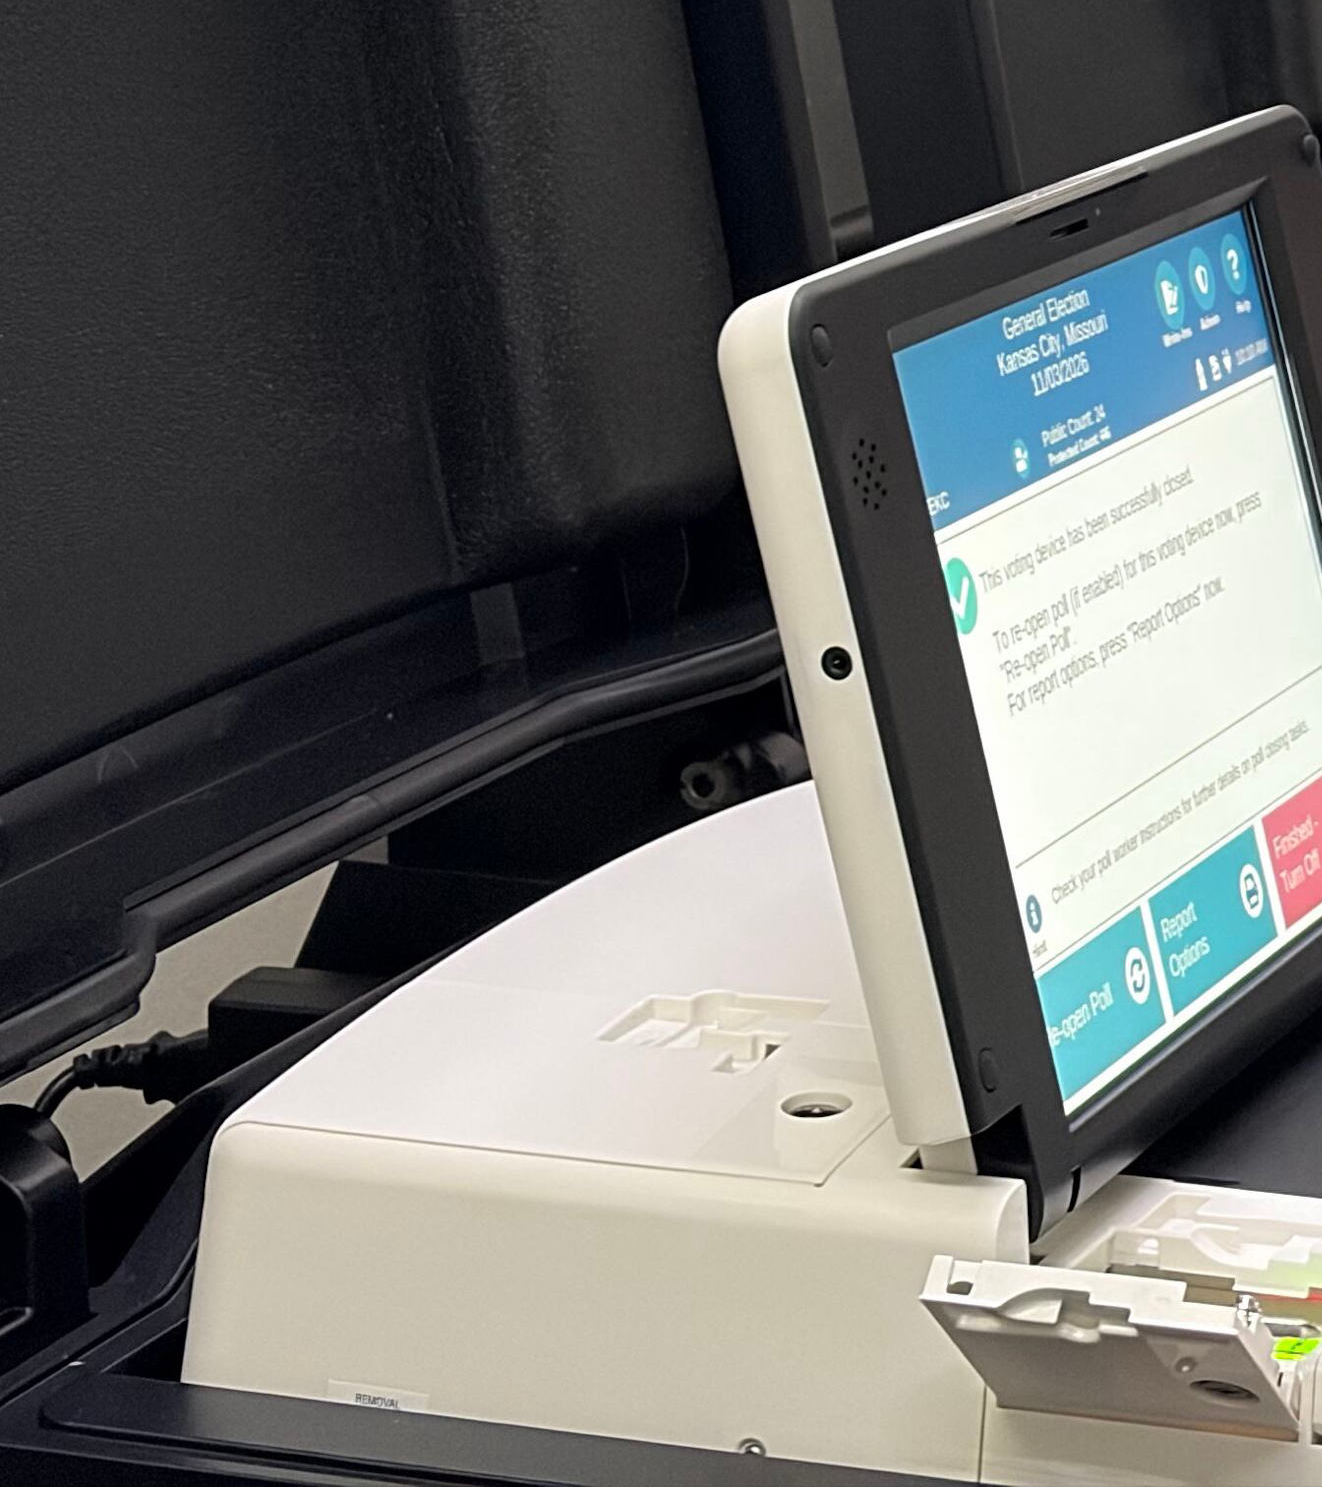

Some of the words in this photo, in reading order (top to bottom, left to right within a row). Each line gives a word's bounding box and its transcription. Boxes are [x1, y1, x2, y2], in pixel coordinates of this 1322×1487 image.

[1002, 303, 1046, 340] General
[1046, 290, 1090, 322] Election
[997, 344, 1040, 376] Kansas
[1039, 333, 1065, 358] City,
[1063, 309, 1108, 346] Missouri
[1031, 351, 1089, 396] 11/03/2026
[1041, 422, 1067, 447] Public
[979, 568, 1003, 592] This
[1003, 553, 1035, 581] voting
[1035, 538, 1066, 563] device
[1066, 526, 1085, 546] has
[1084, 512, 1110, 538] been
[1110, 481, 1162, 524] successfully
[992, 630, 1009, 652] To
[1010, 608, 1051, 643] re-open
[1051, 592, 1070, 627] poll
[1082, 564, 1124, 603] enabled)
[1123, 559, 1138, 581] for
[1138, 549, 1157, 572] this
[1157, 534, 1186, 561] voting
[1185, 523, 1215, 546] device
[1236, 491, 1262, 524] press
[1007, 691, 1027, 717] For
[1028, 669, 1060, 705] report
[1099, 632, 1128, 668] press
[1272, 813, 1315, 860] Finished
[1051, 874, 1079, 904] Check
[1078, 863, 1097, 892] your
[1097, 849, 1112, 878] poll
[1160, 900, 1198, 943] Report
[1168, 935, 1211, 978] Options
[1049, 1003, 1091, 1047] e-open
[1089, 981, 1115, 1016] Poll
[354, 1392, 400, 1409] REMOVAL
